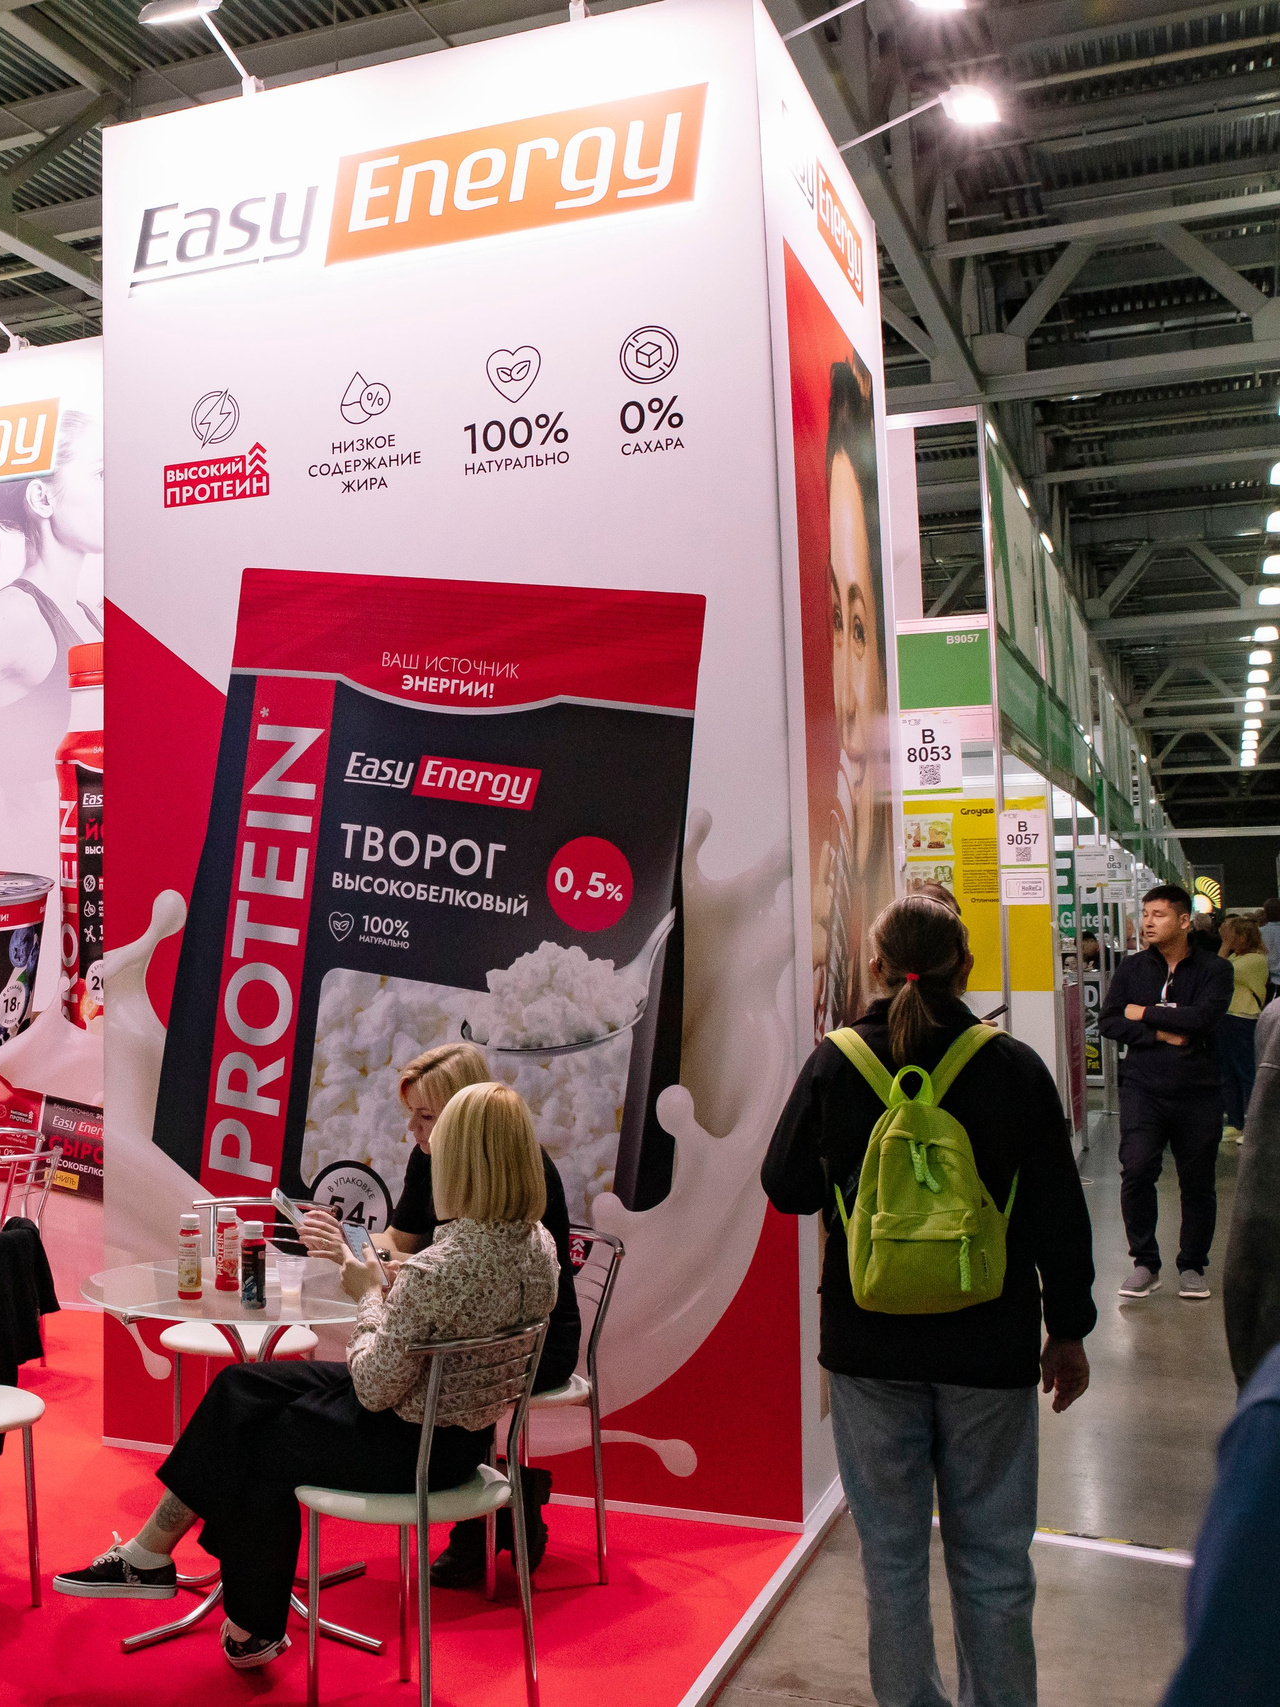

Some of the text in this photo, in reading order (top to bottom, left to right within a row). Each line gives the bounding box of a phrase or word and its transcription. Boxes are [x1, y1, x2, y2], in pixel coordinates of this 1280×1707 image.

[128, 112, 682, 292] Easy Energy
[819, 165, 862, 293] Energy
[619, 396, 685, 435] 0%
[331, 434, 396, 456] НИЗКОЕ
[464, 411, 569, 456] 100%
[621, 437, 685, 457] САХАРА
[166, 456, 244, 485] ВЫСОКИЙ
[308, 450, 422, 479] СОДЕРЖАНИЕ
[464, 450, 570, 476] НАТУРАЛЬНО
[166, 474, 268, 507] ПРОТЕИН
[341, 477, 388, 494] ЖИРА
[946, 634, 980, 645] B9057
[382, 651, 520, 680] ВАШ ИСТОЧНИК
[401, 674, 495, 699] ЭНЕРГИИ!
[907, 745, 952, 763] 8053
[344, 752, 532, 804] Easy Energy
[340, 823, 506, 879] ТВОРОГ
[1007, 834, 1039, 846] 9057
[332, 871, 529, 917] ВЫСОКОБЕЛКОВЫЙ
[554, 866, 624, 902] 0,5%
[60, 800, 78, 1021] ROTEIN
[362, 915, 410, 938] 100%
[359, 934, 410, 950] НАТУРАЛЬНО
[91, 975, 104, 990] 2
[52, 1115, 77, 1131] Easy
[334, 1176, 376, 1200] УПАКОВКЕ
